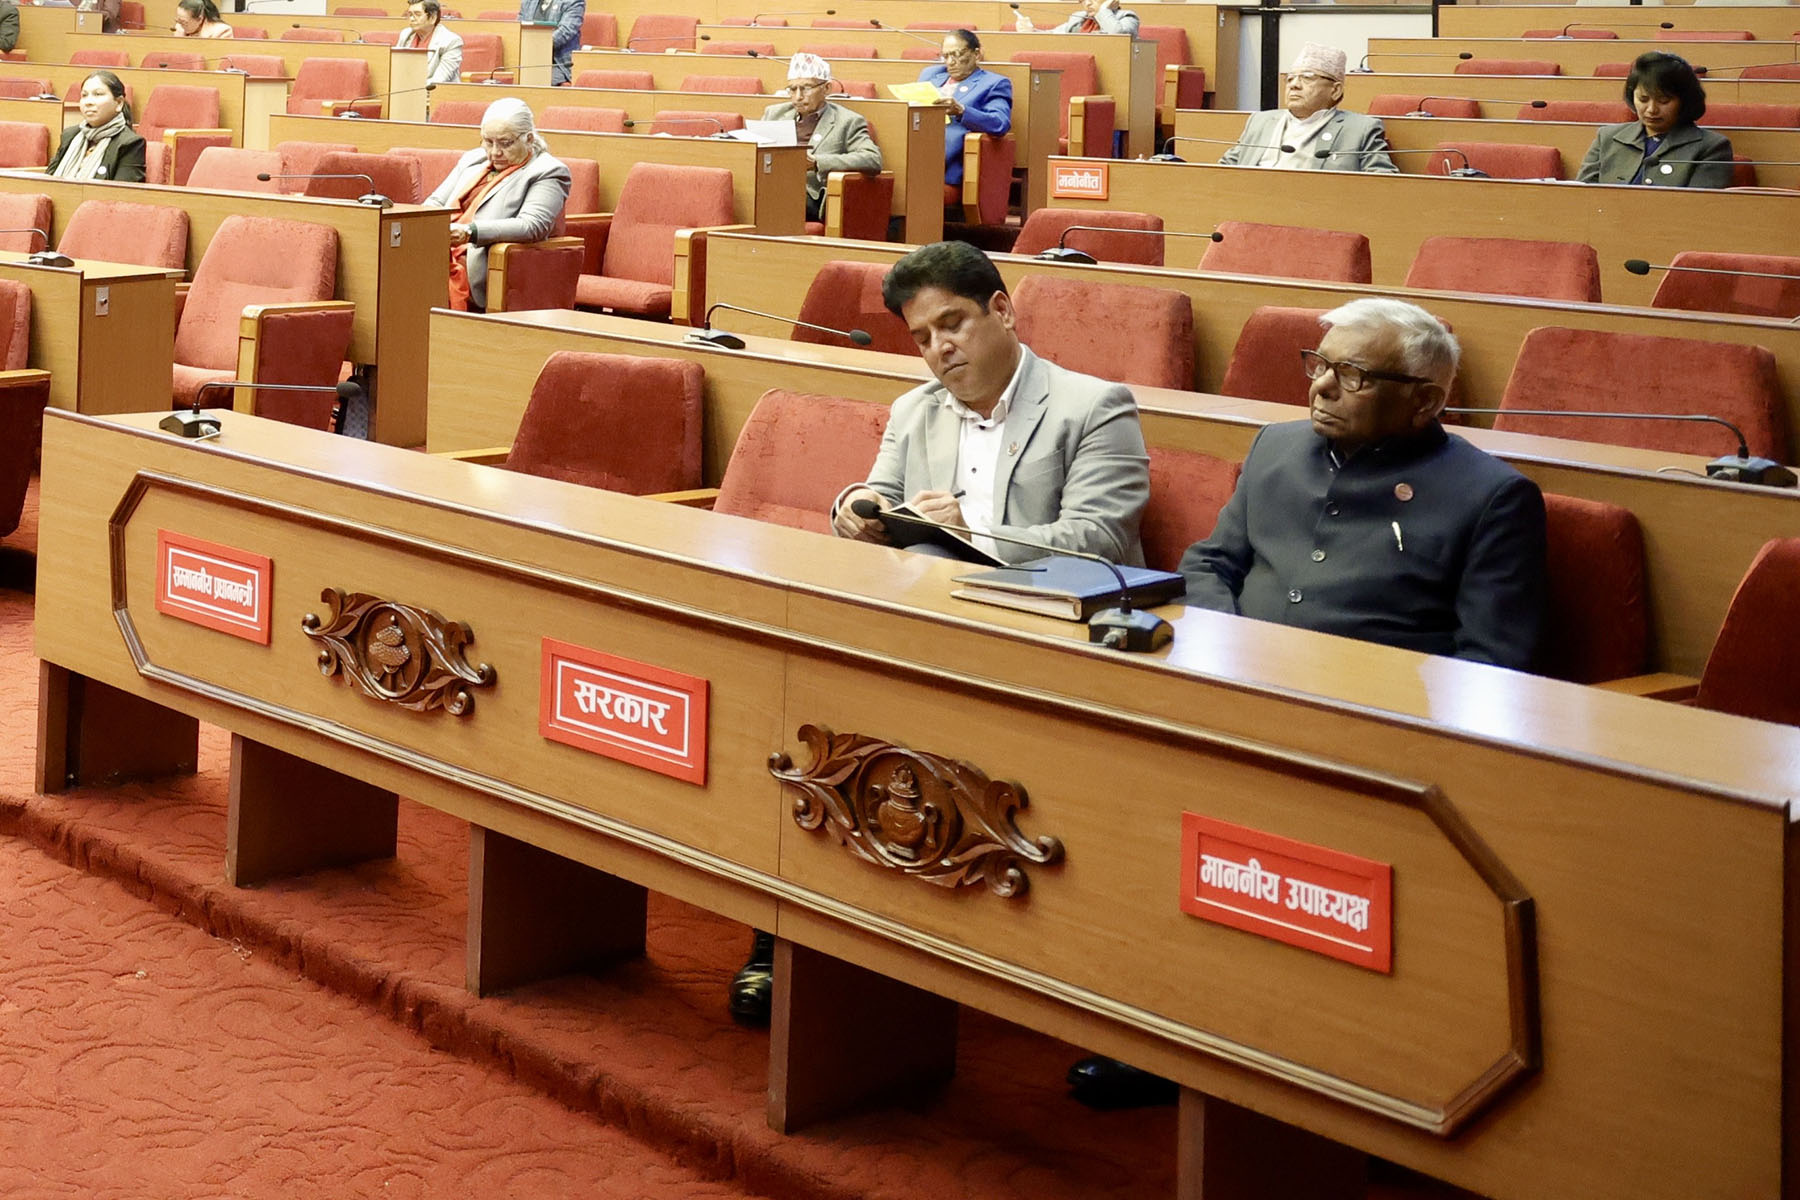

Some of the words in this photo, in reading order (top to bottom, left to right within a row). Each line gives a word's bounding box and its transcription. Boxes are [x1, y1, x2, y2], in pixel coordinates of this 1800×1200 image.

[1059, 171, 1099, 189] मनोनीत
[173, 565, 213, 596] सम्माननीय
[573, 678, 671, 736] सरकार
[1200, 854, 1281, 904] माननीय
[1285, 877, 1370, 932] उपाध्यक्ष
